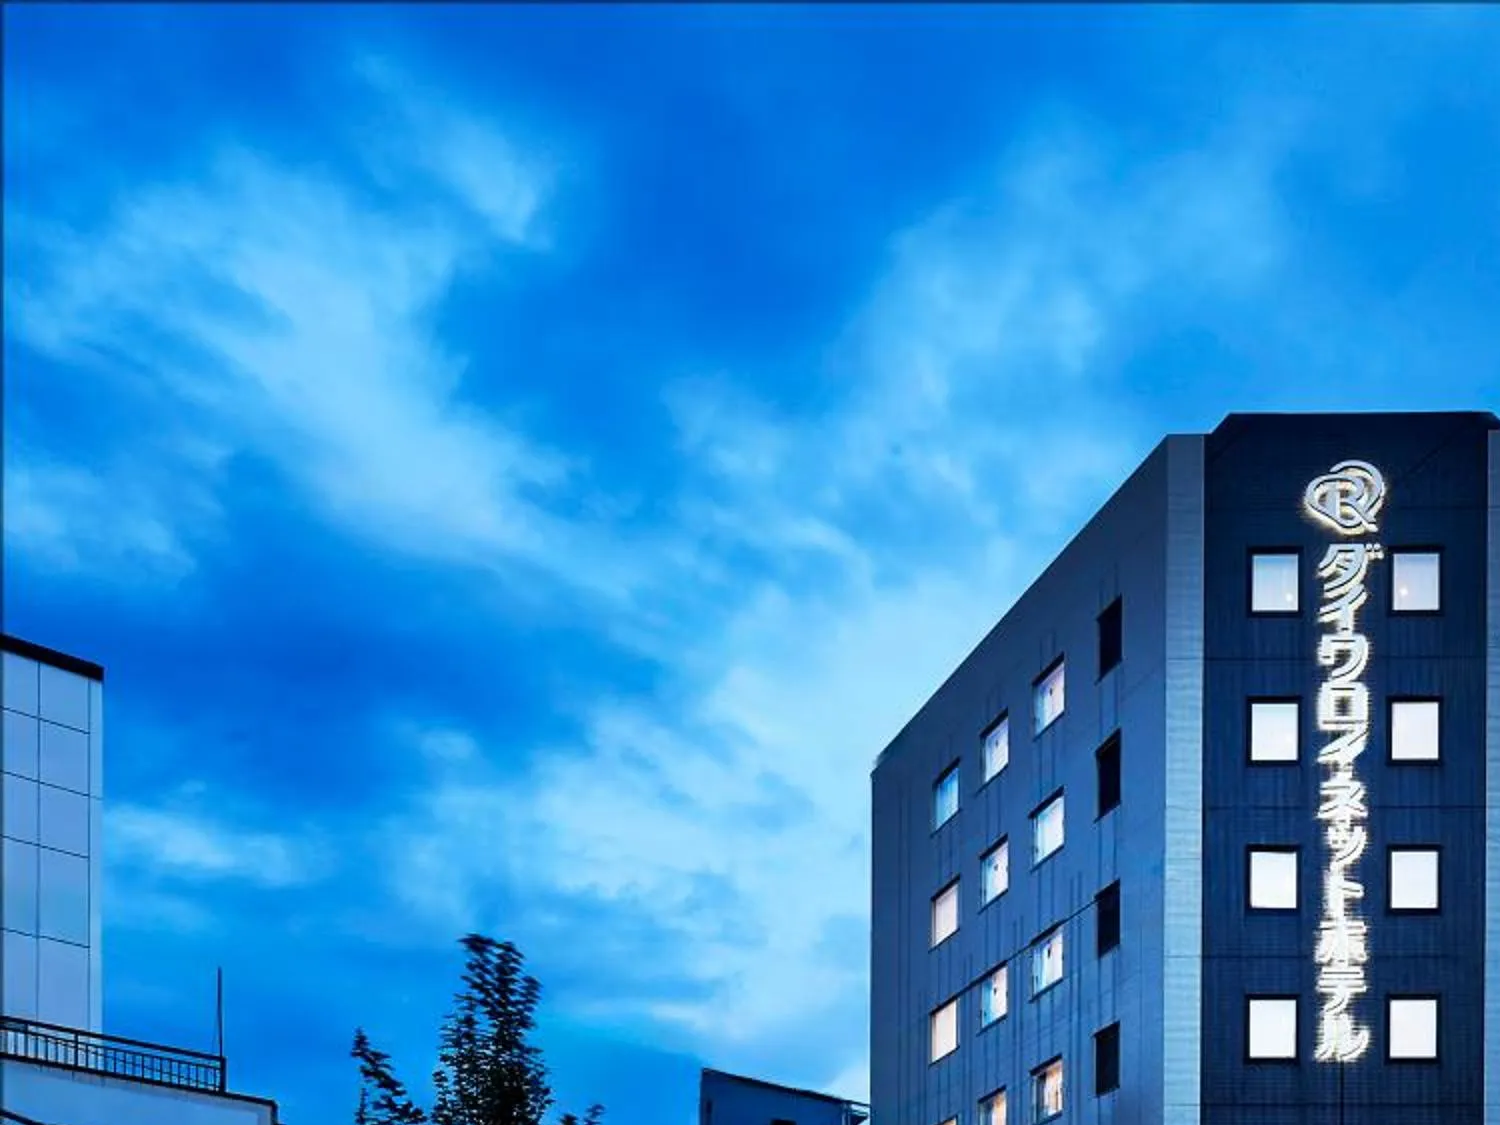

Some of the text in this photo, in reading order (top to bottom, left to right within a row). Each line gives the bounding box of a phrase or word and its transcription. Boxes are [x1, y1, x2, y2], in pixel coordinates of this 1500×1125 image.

[1315, 543, 1383, 1063] ダイワロイネットホテル
